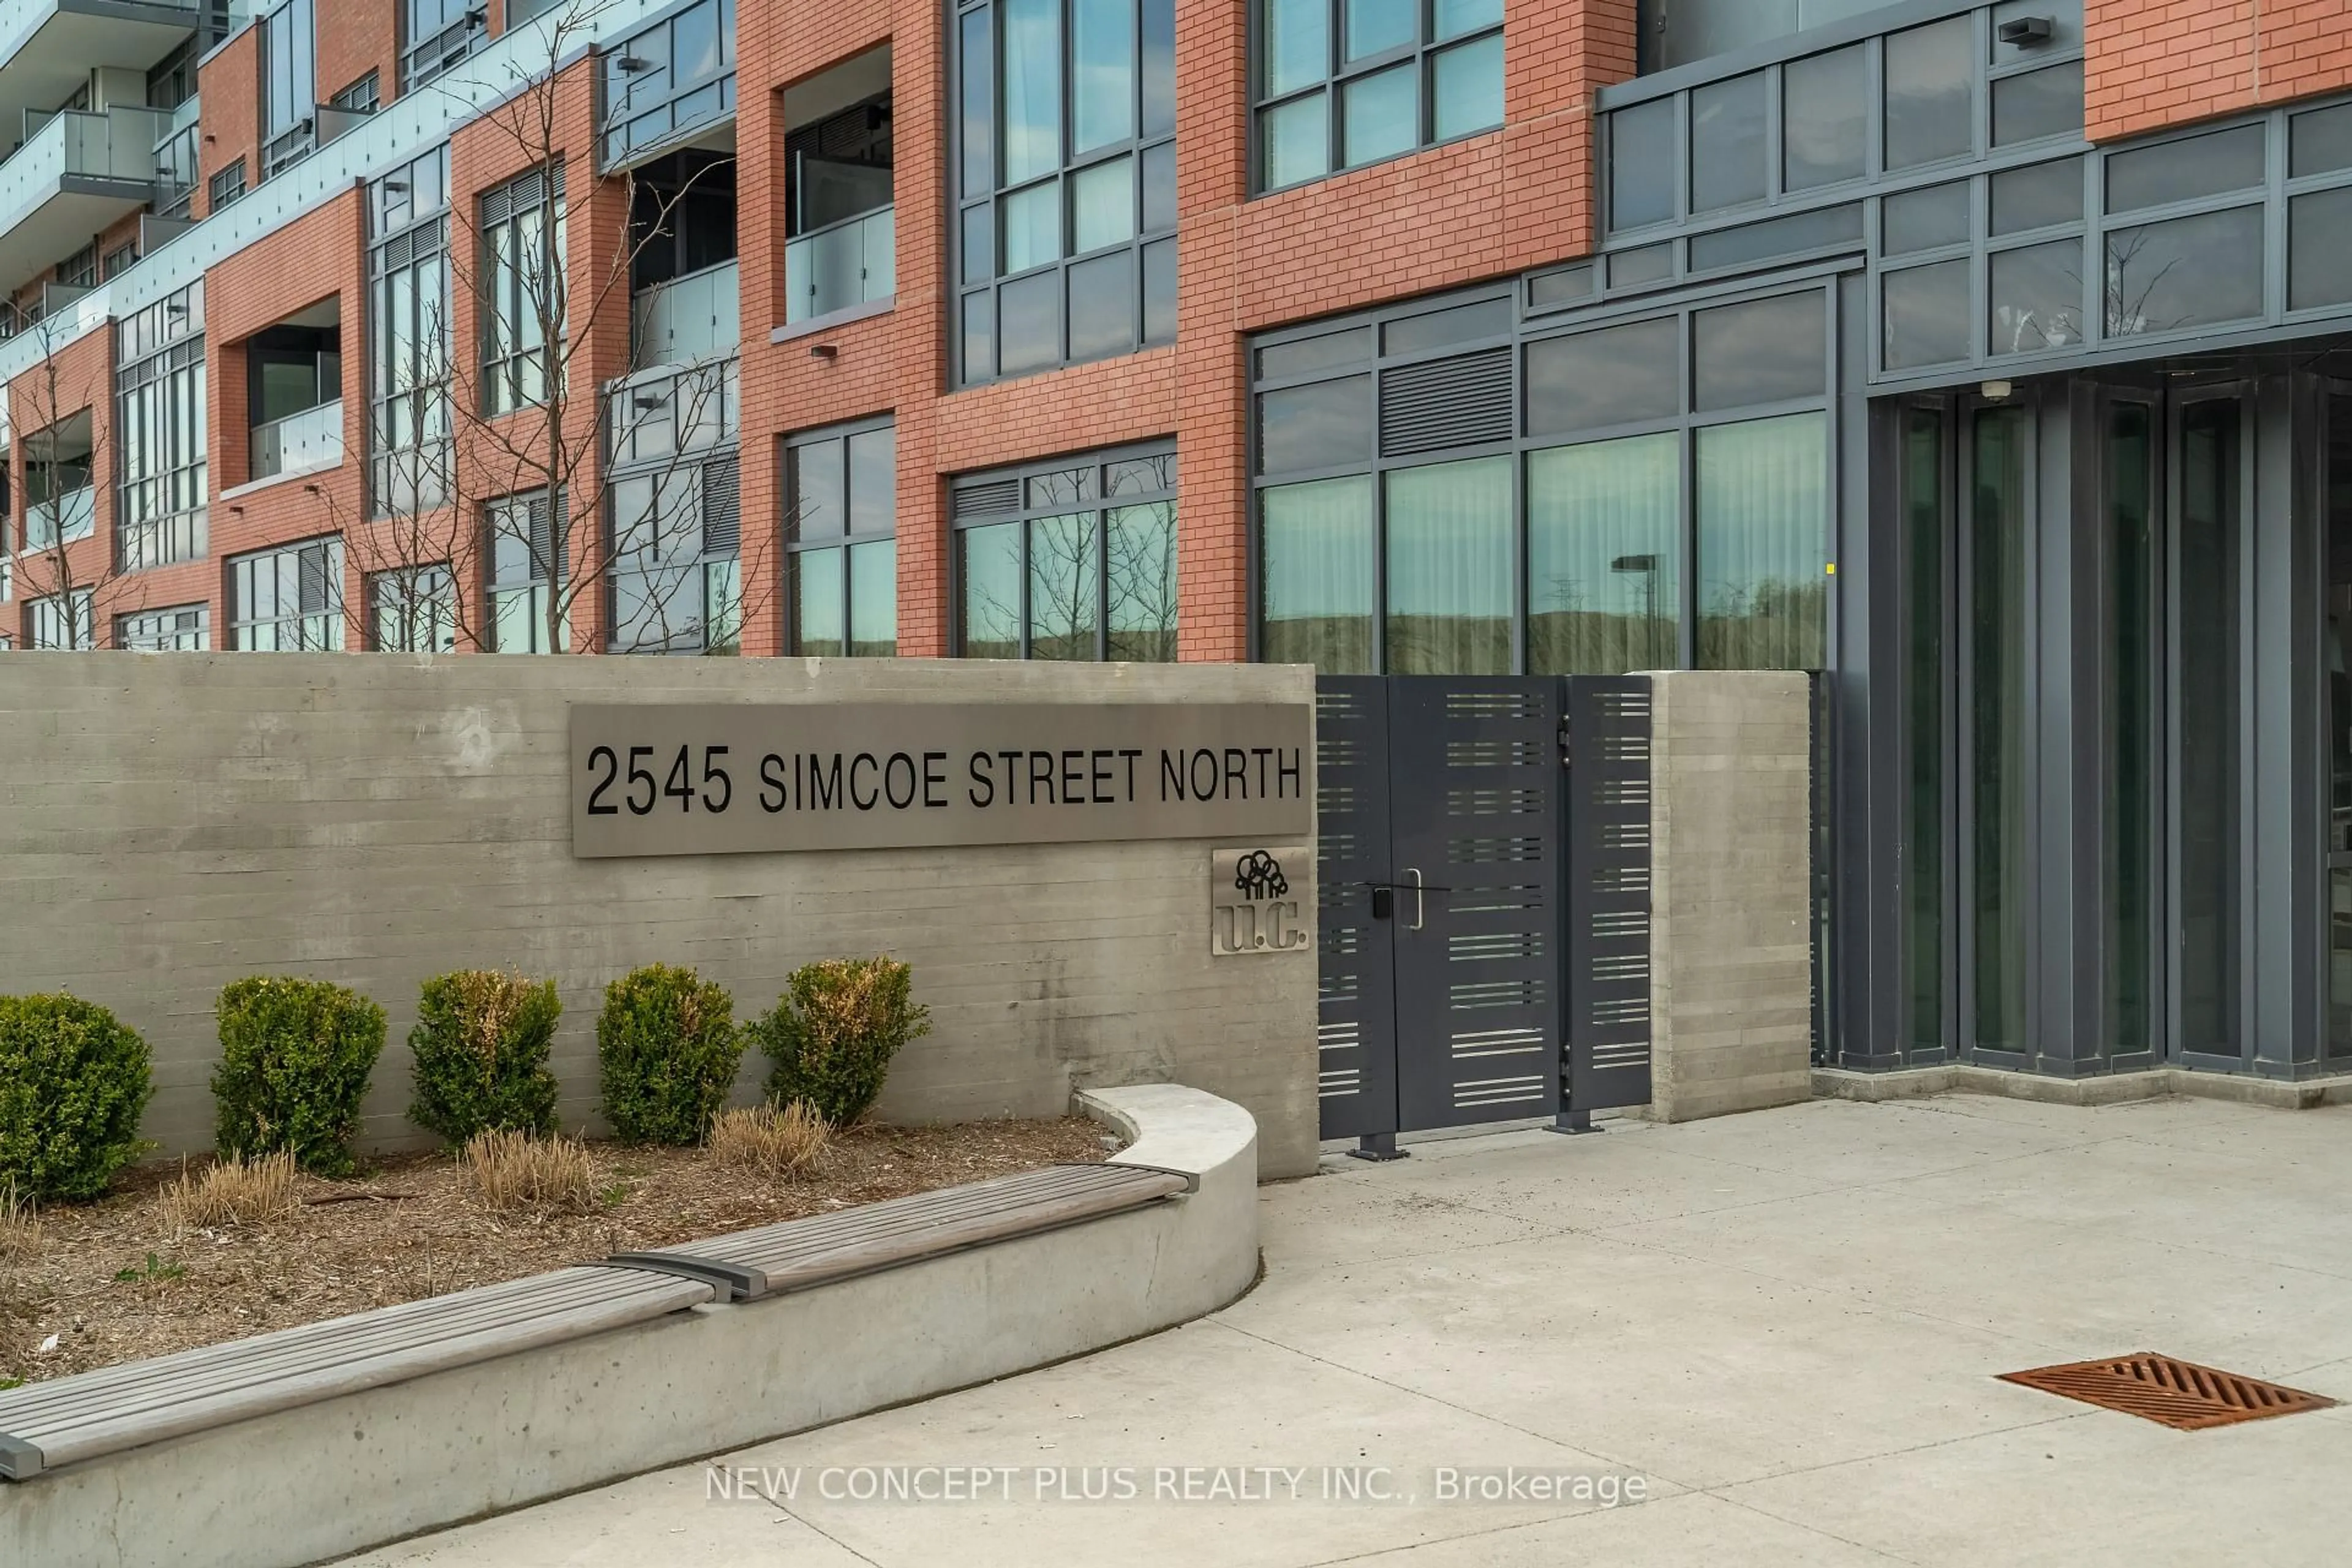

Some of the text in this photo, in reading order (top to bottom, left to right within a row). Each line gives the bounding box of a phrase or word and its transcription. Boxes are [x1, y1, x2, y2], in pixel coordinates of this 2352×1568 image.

[587, 745, 1300, 816] 2545 SIMCOE STREET NORTH
